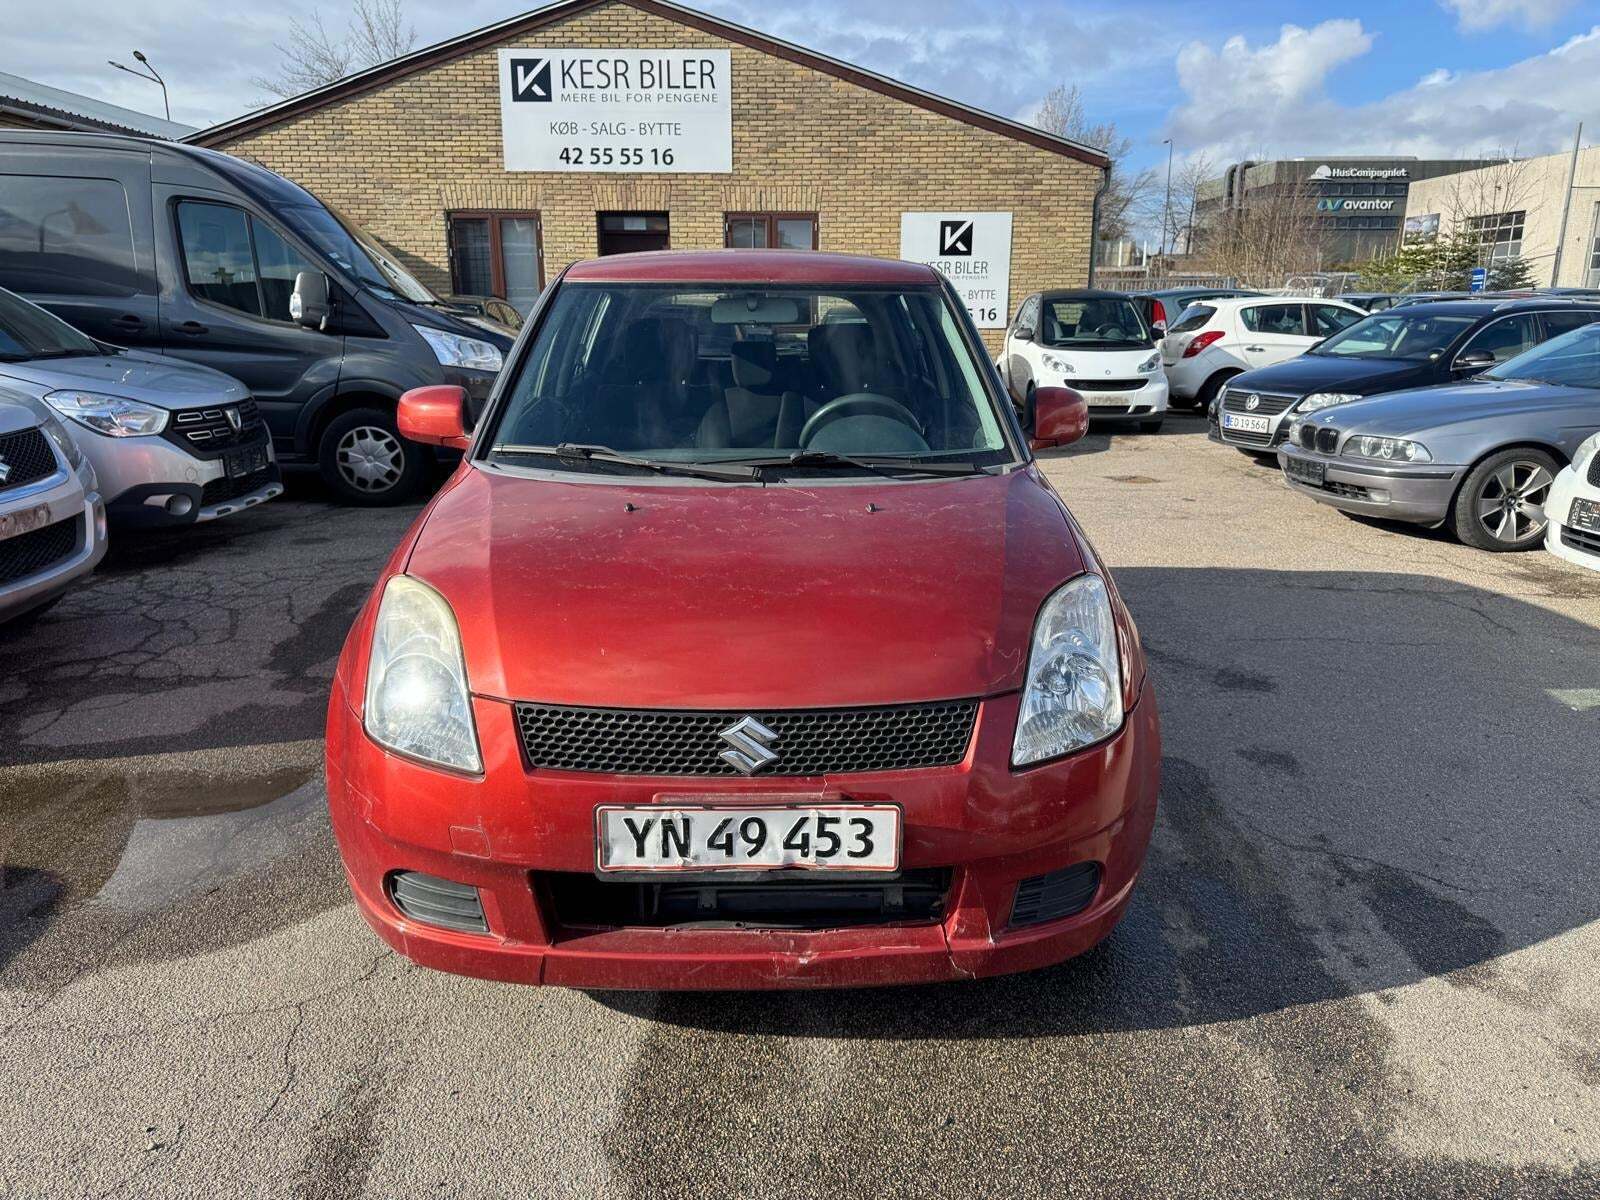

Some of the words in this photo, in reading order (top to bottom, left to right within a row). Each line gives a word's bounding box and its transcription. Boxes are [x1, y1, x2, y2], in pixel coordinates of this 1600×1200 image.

[561, 59, 630, 89] KESR
[640, 59, 716, 89] BILER
[561, 93, 596, 102] MERE
[601, 93, 621, 103] BIL
[626, 93, 652, 103] FOR
[657, 93, 718, 103] PENGENE
[550, 121, 578, 135] KØB
[590, 122, 626, 136] SALG
[639, 122, 681, 136] BYTTE
[559, 147, 583, 165] 42
[590, 148, 613, 165] 55
[620, 148, 643, 165] 55
[653, 148, 674, 165] 16
[1332, 168, 1407, 178] HusCompagniet
[1343, 200, 1394, 210] avantor
[955, 261, 988, 274] BILER
[968, 289, 996, 300] BYTTE
[979, 308, 997, 321] 16
[1251, 419, 1266, 430] 564
[623, 817, 691, 858] YN
[706, 817, 768, 858] 49
[782, 817, 874, 858] 453
